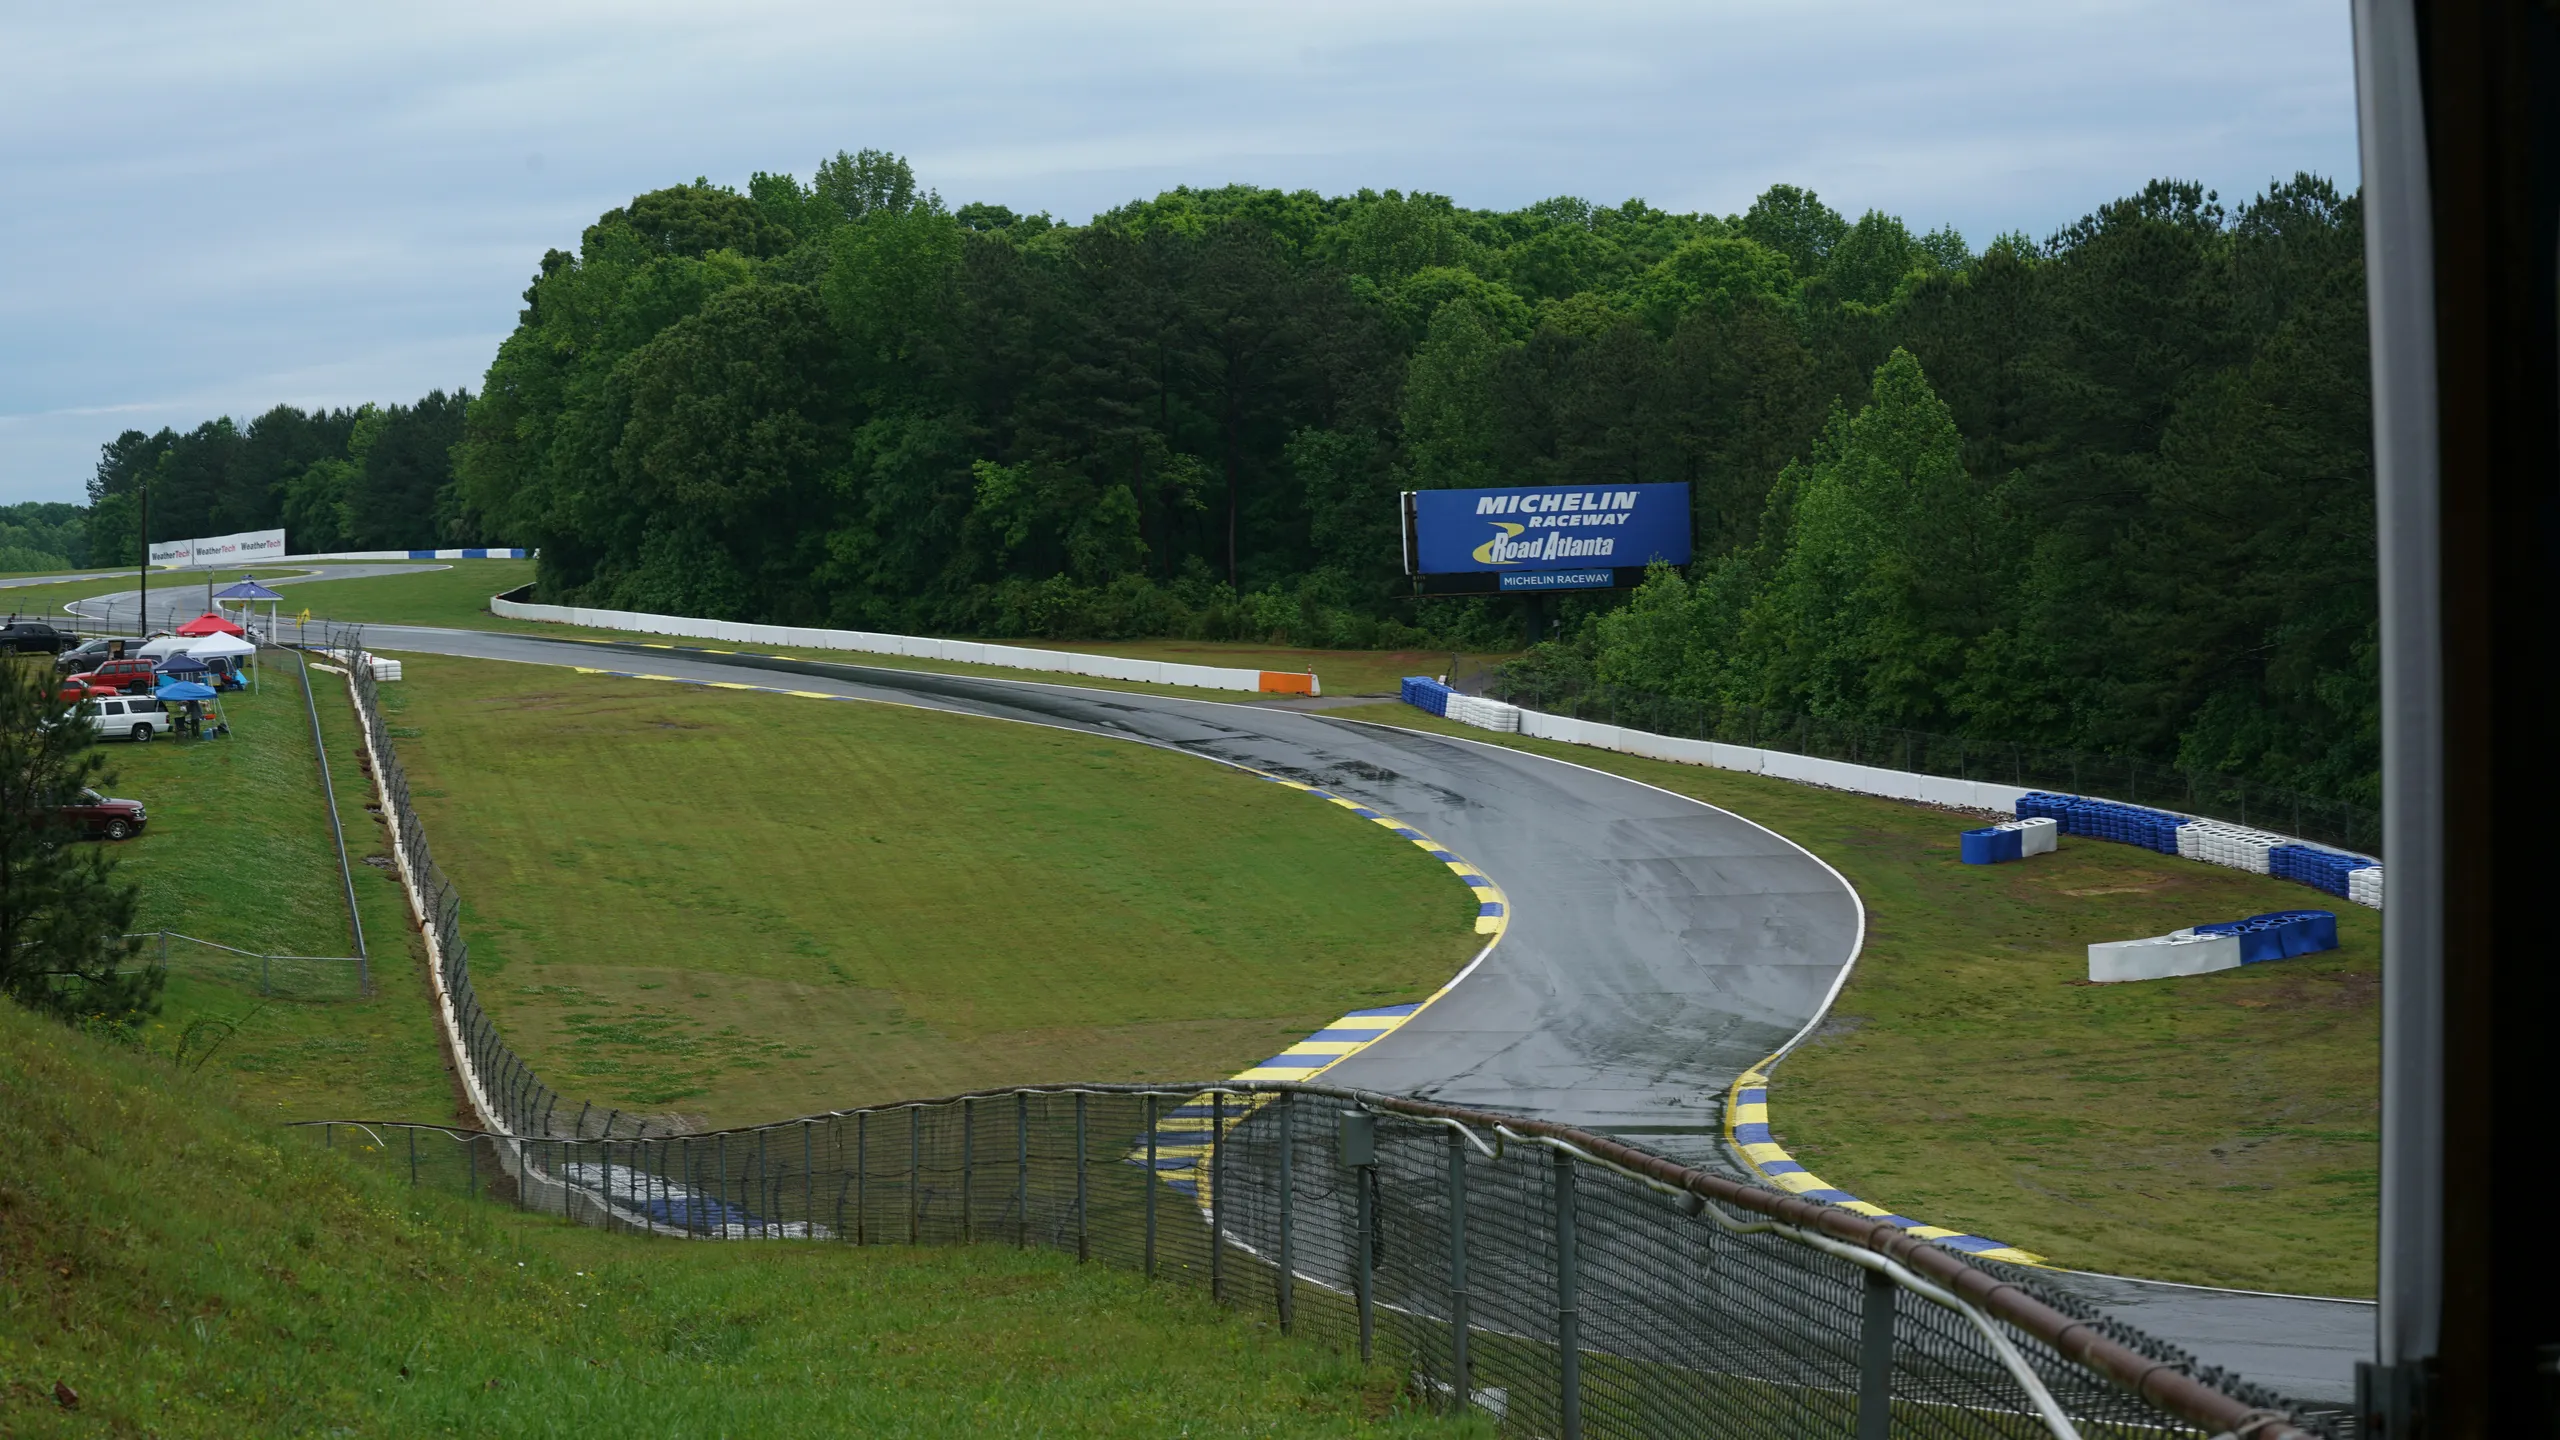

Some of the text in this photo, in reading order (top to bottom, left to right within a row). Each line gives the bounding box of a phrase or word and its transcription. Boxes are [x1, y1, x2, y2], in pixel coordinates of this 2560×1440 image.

[1476, 491, 1638, 515] MICHELIN
[1529, 513, 1630, 527] RACEWAY
[196, 545, 236, 556] WeatherTech
[241, 540, 281, 551] WeatherTech
[1490, 531, 1614, 563] Road Atlanta
[152, 550, 190, 561] WeatherTech
[1504, 573, 1609, 585] MICHELIN RACEWAY
